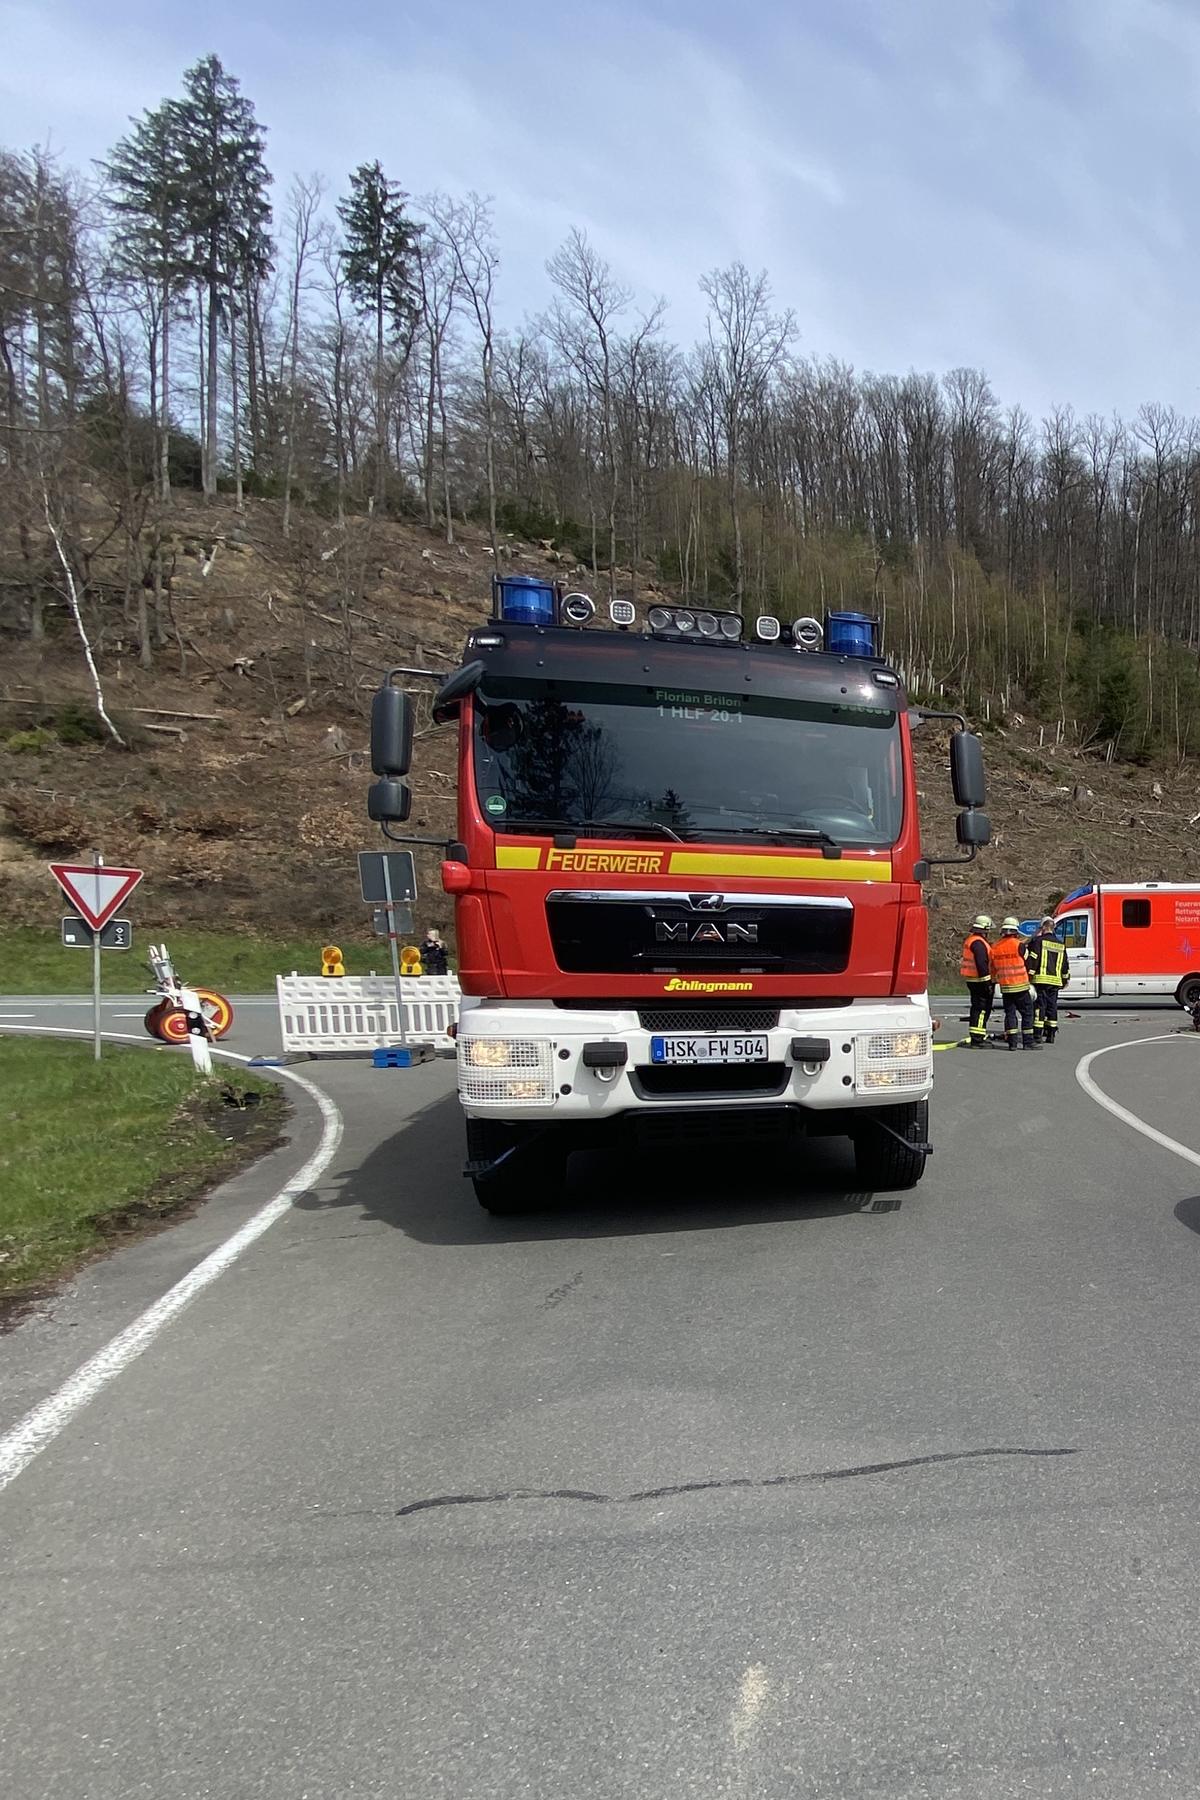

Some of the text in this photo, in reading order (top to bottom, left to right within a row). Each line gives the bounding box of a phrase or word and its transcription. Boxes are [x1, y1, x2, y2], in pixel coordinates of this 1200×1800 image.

[656, 690, 741, 707] Florian Brilon
[656, 705, 742, 723] 1 HLF 20.1
[546, 848, 664, 873] FEUERWEHR
[655, 922, 758, 943] MAN
[664, 978, 753, 992] Schlingmann
[665, 1041, 697, 1057] HSK
[708, 1040, 729, 1056] FW
[734, 1039, 763, 1055] 504
